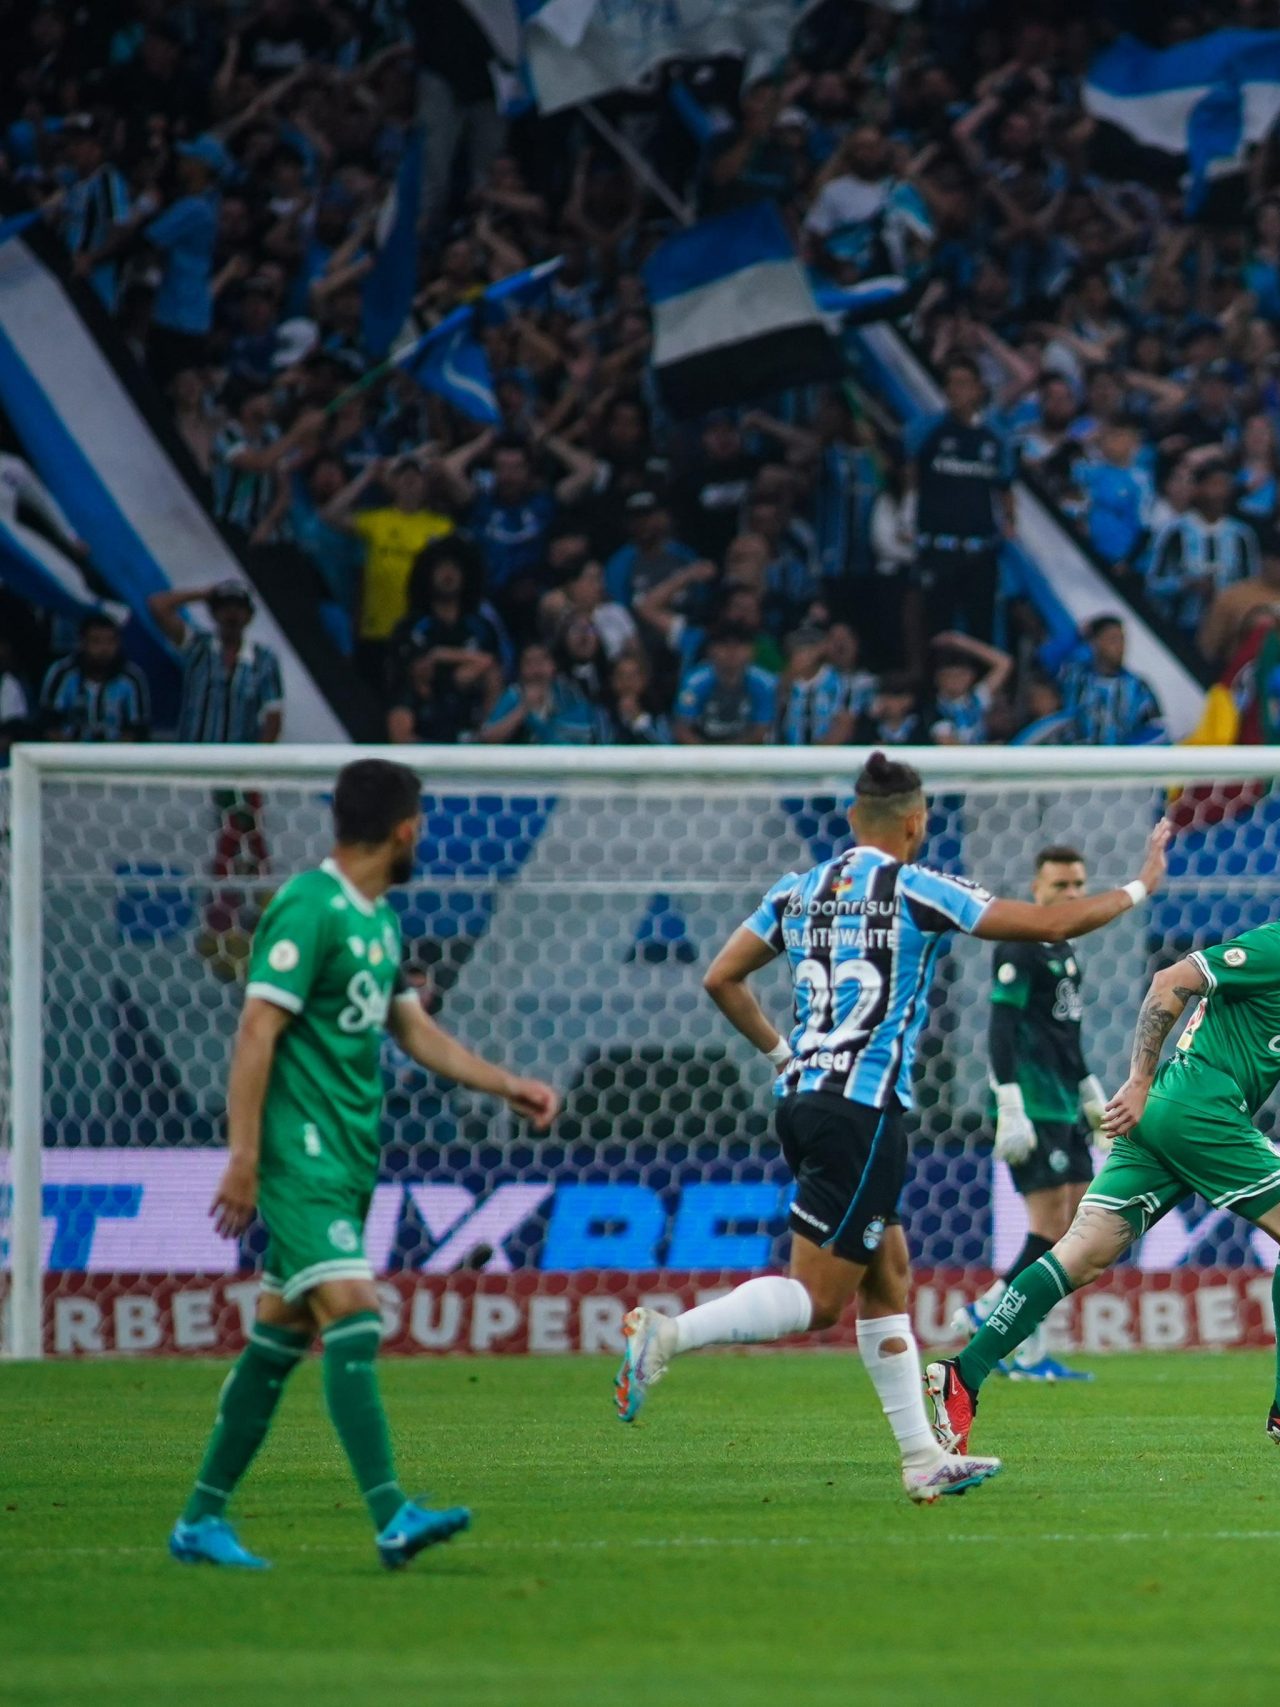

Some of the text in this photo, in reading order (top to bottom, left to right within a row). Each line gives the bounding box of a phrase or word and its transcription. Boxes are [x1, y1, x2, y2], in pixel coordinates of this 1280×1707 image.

[806, 896, 901, 916] banrisul
[783, 928, 898, 949] BRAITHWAITE
[795, 958, 882, 1054] 22
